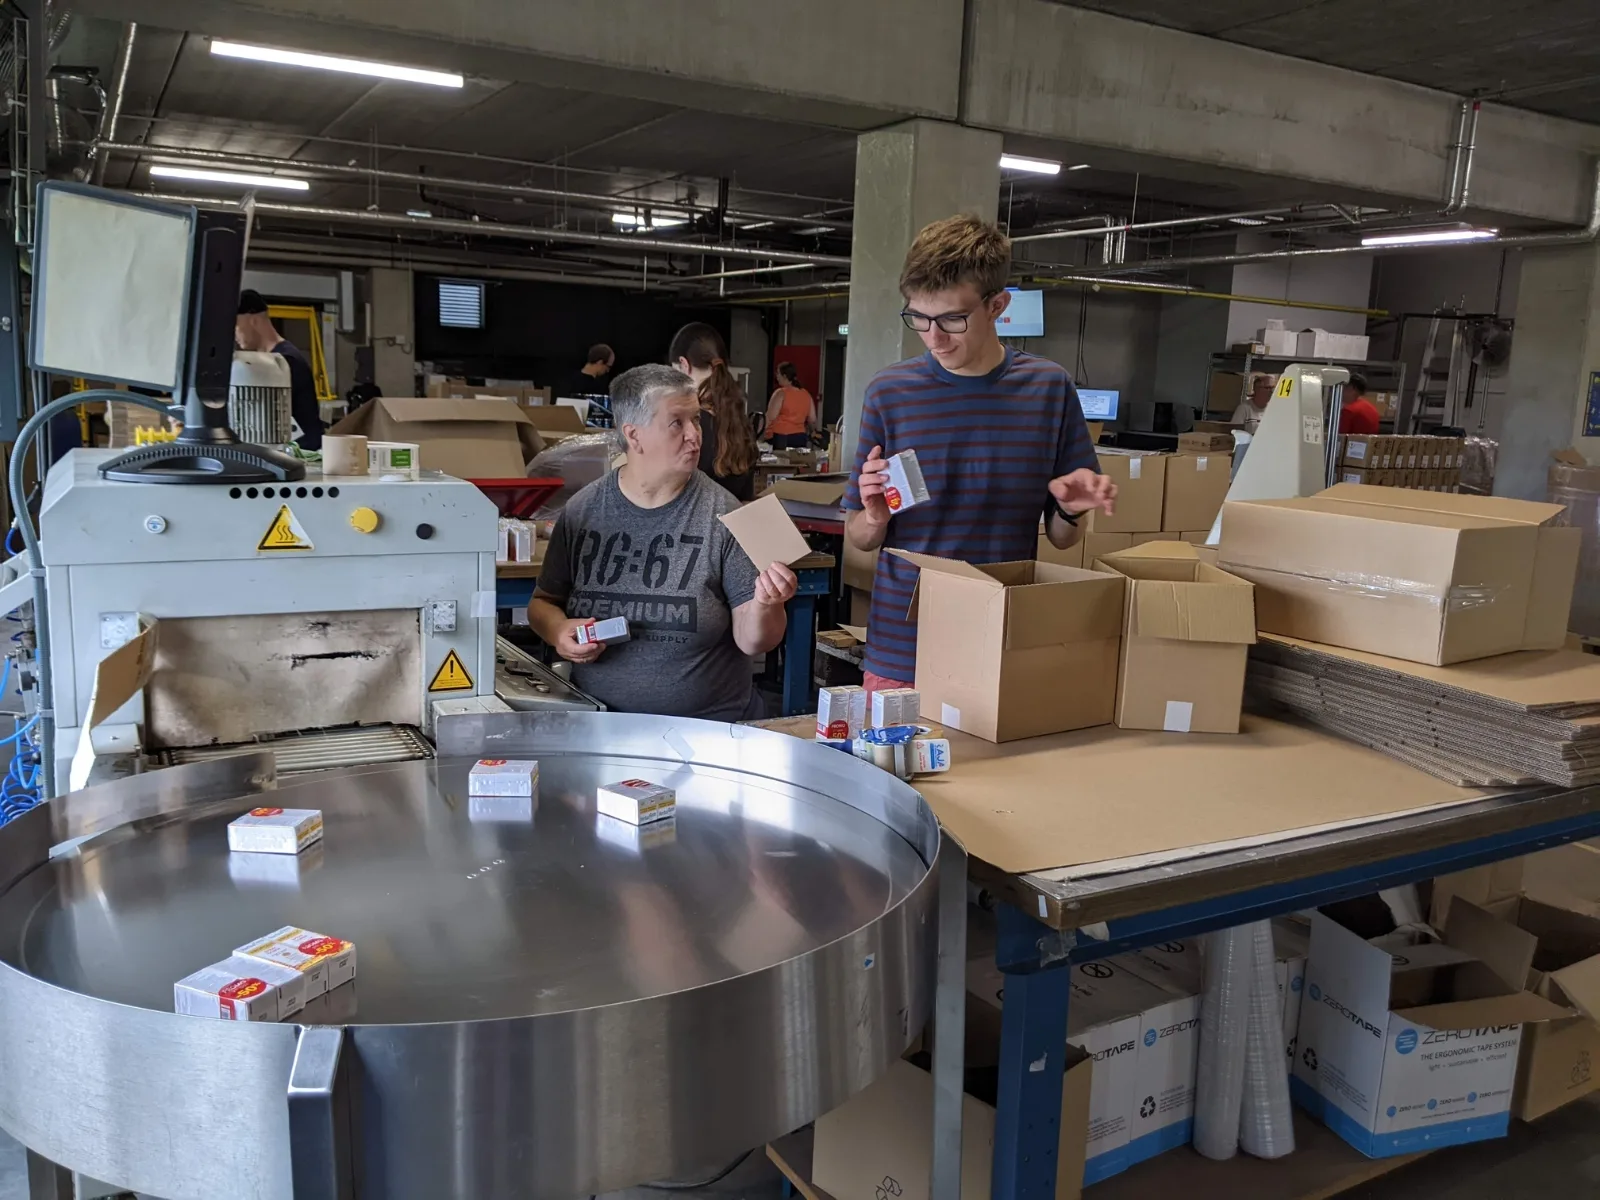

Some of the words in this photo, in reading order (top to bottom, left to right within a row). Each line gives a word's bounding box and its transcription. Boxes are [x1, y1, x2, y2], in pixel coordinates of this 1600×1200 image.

[1279, 378, 1293, 397] 14
[571, 528, 704, 591] RG:67
[567, 597, 690, 624] PREMIUM
[645, 633, 689, 644] SUPPLY
[236, 981, 261, 999] -50%
[1323, 994, 1382, 1039] ZEROTAPE
[1420, 1052, 1432, 1060] THE
[1434, 1046, 1475, 1059] ERGONOMIC
[1477, 1043, 1492, 1052] TAPE
